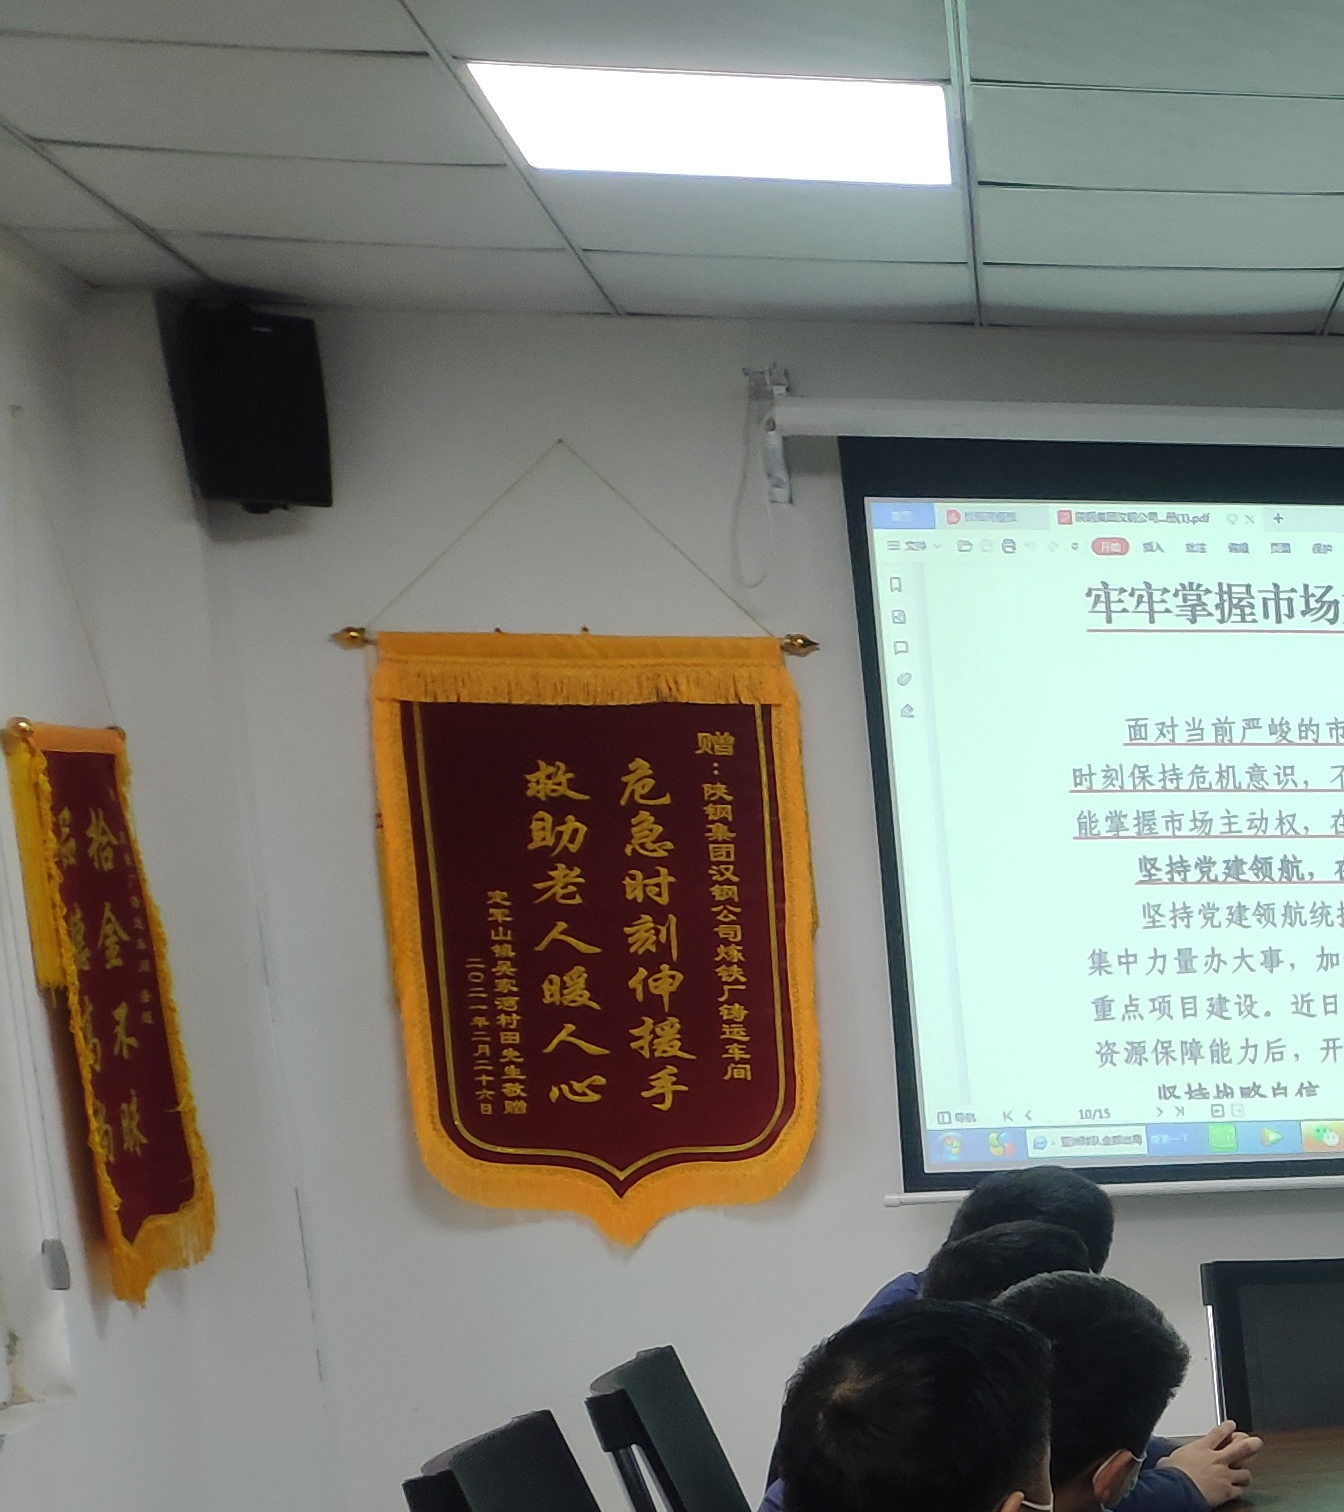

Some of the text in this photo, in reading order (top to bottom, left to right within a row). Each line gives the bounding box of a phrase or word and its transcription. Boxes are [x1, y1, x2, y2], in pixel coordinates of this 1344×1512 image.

[523, 759, 611, 1106] 救助老人暖人心
[617, 756, 697, 1112] 危急时刻伸援手
[1079, 1108, 1111, 1120] 10/15
